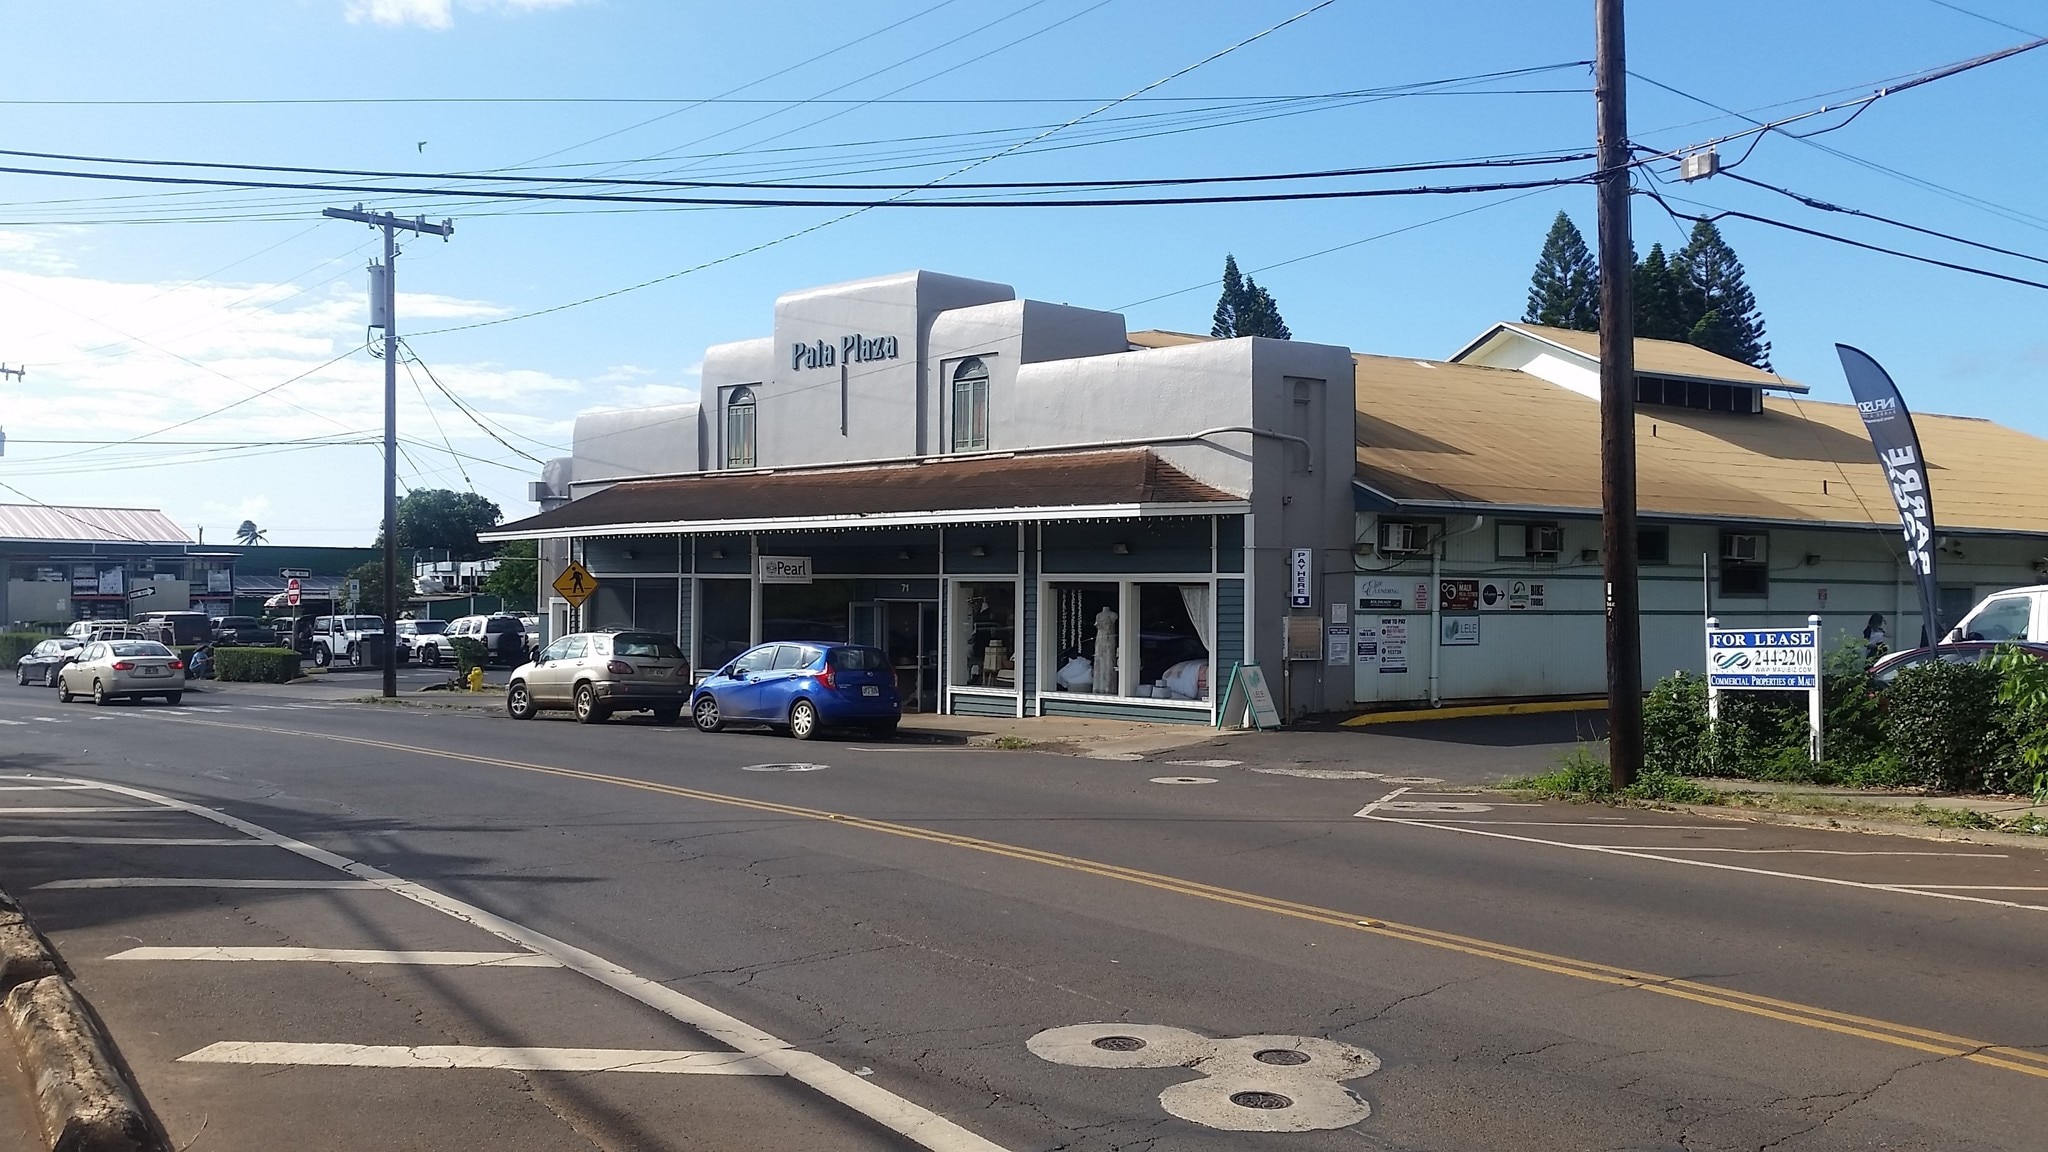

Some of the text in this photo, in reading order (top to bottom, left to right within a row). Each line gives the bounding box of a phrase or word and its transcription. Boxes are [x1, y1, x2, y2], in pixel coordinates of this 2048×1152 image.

[791, 333, 899, 371] Paia Plaza
[777, 560, 806, 576] Pearl
[1297, 552, 1306, 595] PAY HERE
[901, 583, 909, 592] 71
[1530, 584, 1544, 596] BIKE
[1530, 598, 1544, 607] TOURS
[1460, 624, 1477, 633] LELE
[1711, 632, 1812, 646] FOR LEASE
[1754, 649, 1812, 666] 244-2200
[1711, 675, 1749, 686] COMMERCIAL
[1751, 675, 1786, 686] PROPERTIES
[1797, 676, 1815, 686] MAUI
